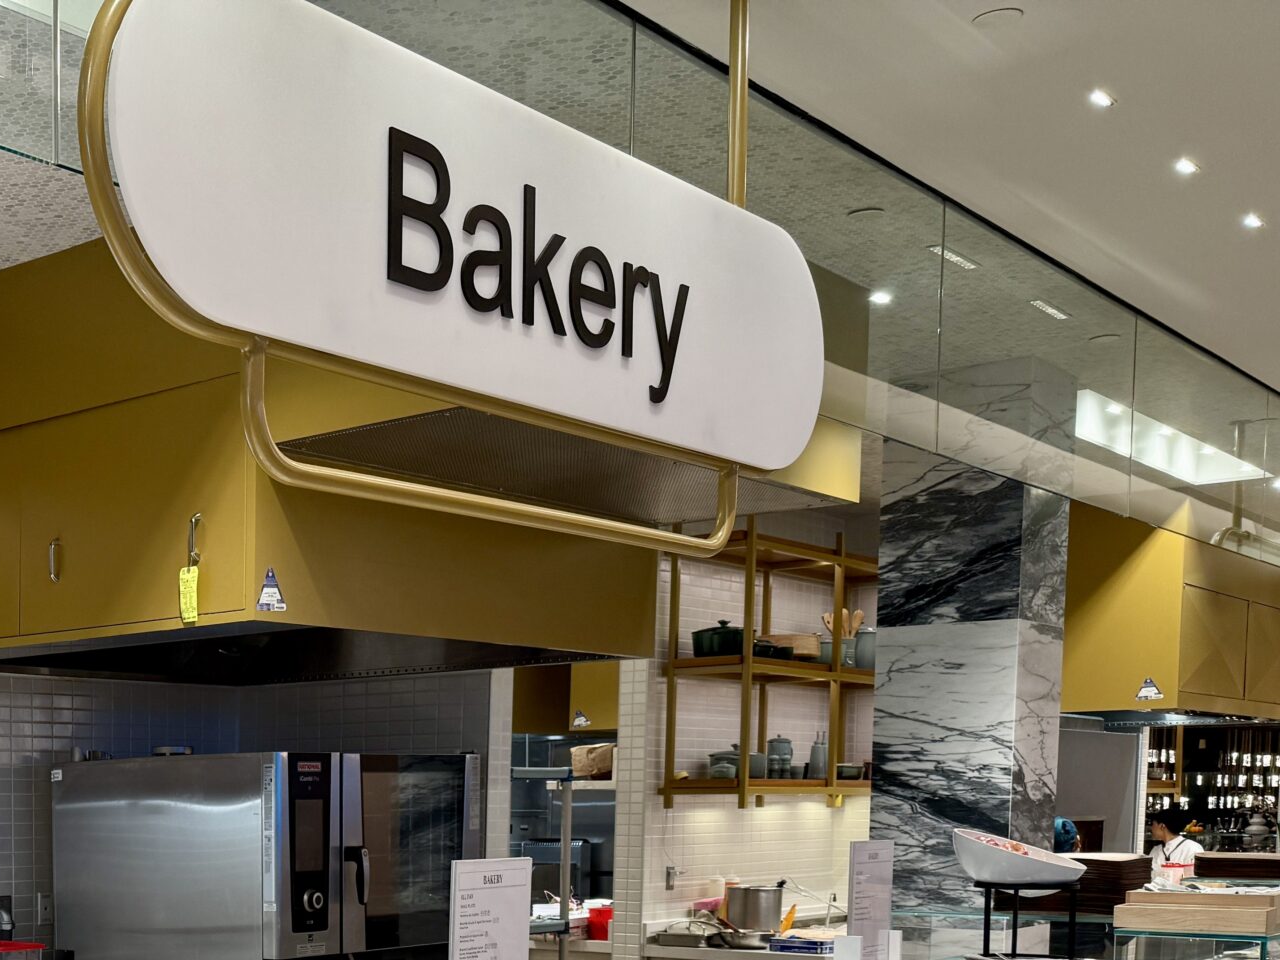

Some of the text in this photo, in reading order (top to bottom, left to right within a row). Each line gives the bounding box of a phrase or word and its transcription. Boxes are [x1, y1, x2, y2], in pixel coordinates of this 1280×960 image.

[387, 127, 690, 404] Bakery
[298, 763, 321, 771] RATIONAL
[483, 874, 503, 884] BAKERY
